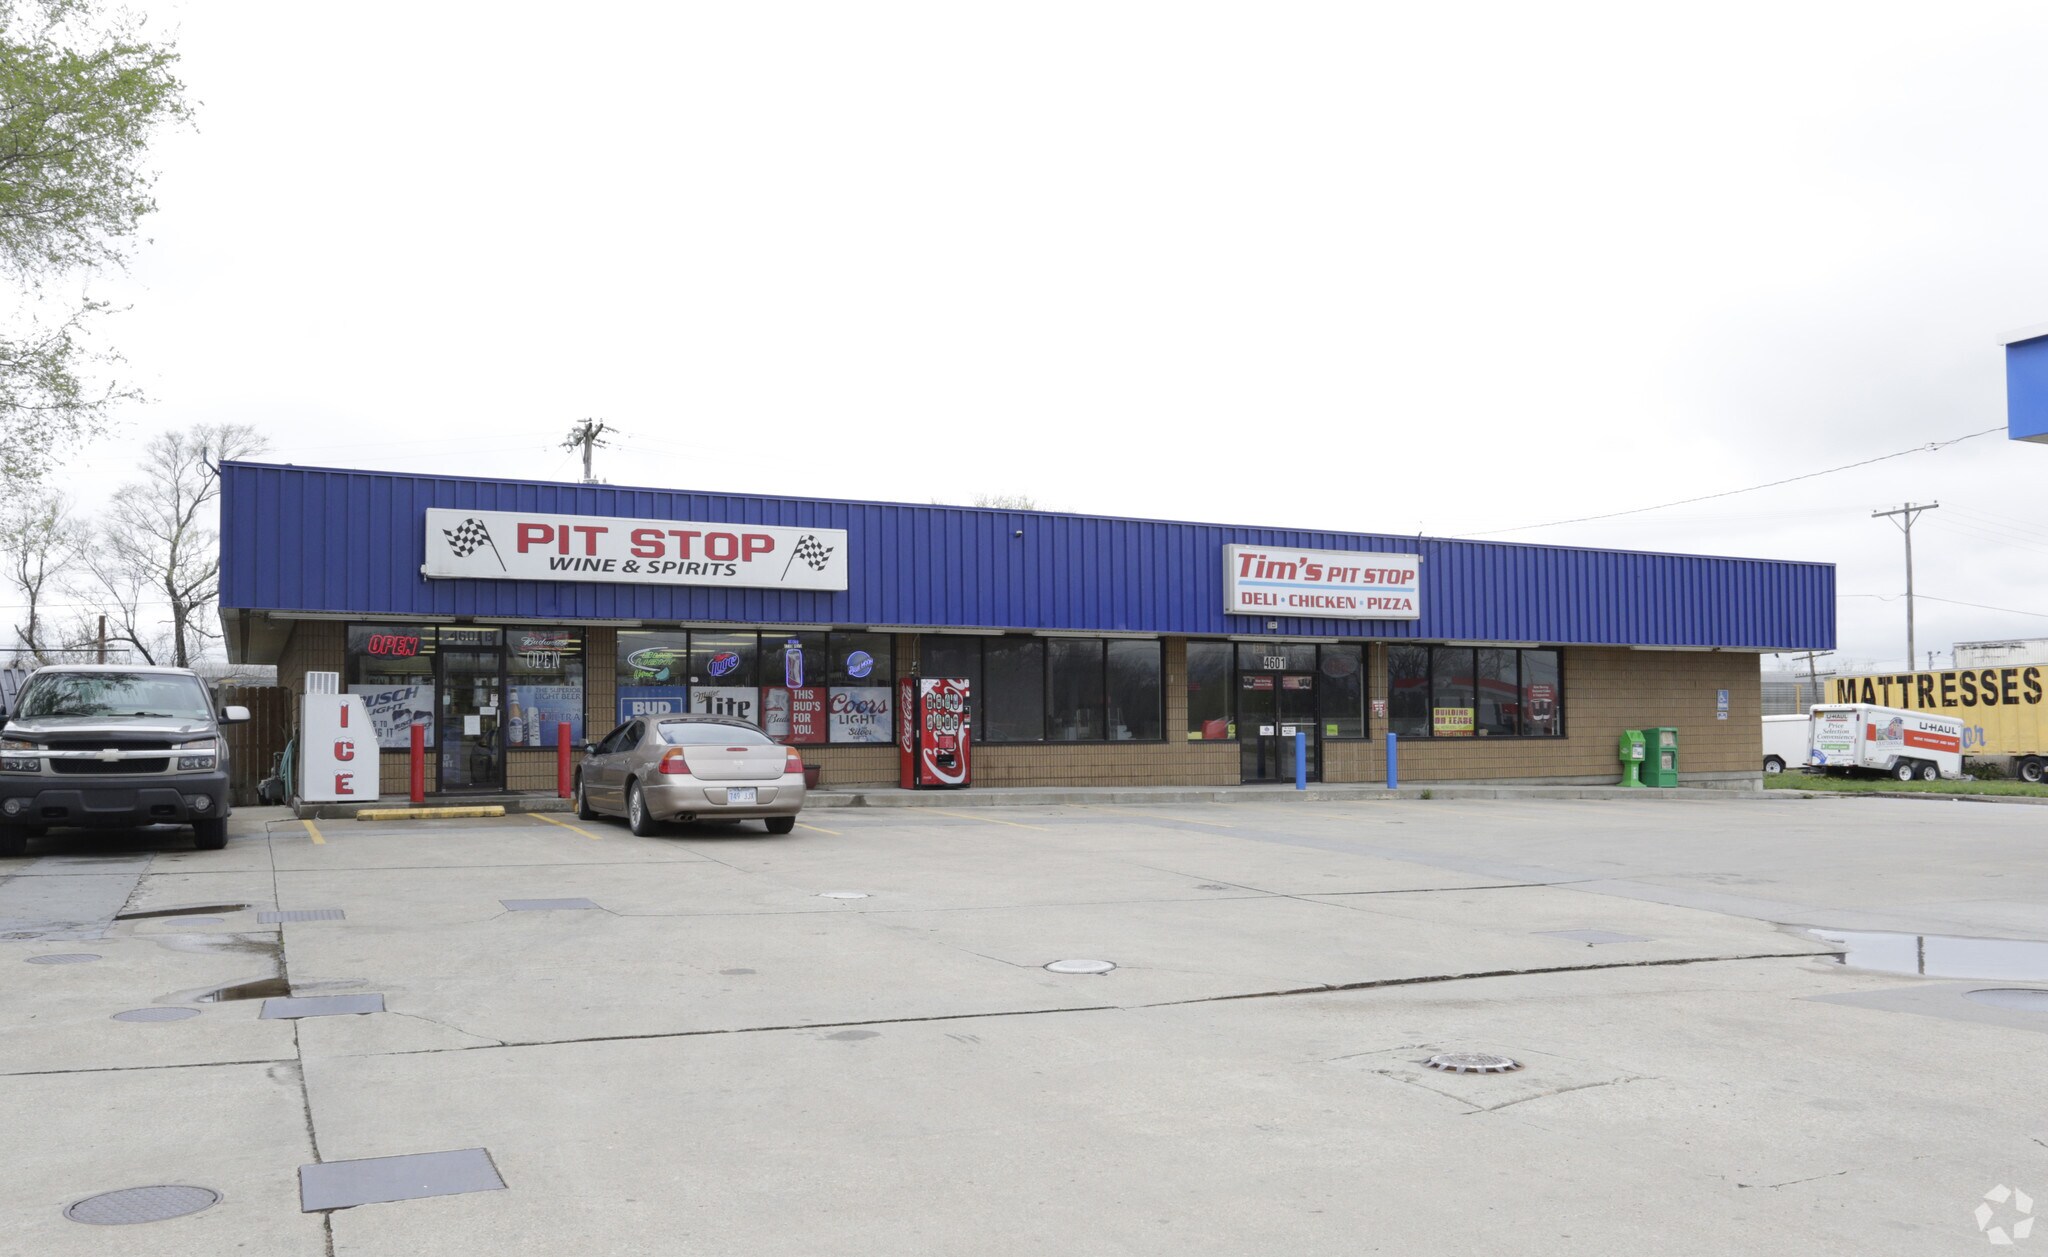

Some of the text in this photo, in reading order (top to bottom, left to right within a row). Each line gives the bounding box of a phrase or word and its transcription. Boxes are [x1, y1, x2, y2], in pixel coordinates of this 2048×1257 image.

[516, 522, 775, 562] PIT STOP
[549, 556, 737, 577] WINE & SPIRITS
[1238, 553, 1415, 585] Tim's PIT STOP
[1241, 592, 1413, 611] DELI CHICKEN PIZZA
[368, 634, 418, 656] OPEN
[526, 651, 560, 668] OPEN
[1264, 657, 1286, 669] 4601
[793, 689, 814, 700] THIS
[1837, 666, 2043, 708] MATTRESSES
[369, 702, 405, 716] IGHT
[632, 701, 672, 716] BUD
[793, 701, 821, 712] BUD'S
[830, 693, 888, 715] Coors
[793, 713, 811, 723] FOR
[839, 714, 877, 725] LIGHT
[793, 724, 814, 735] YOU.
[1919, 722, 1957, 735] U-HAUL
